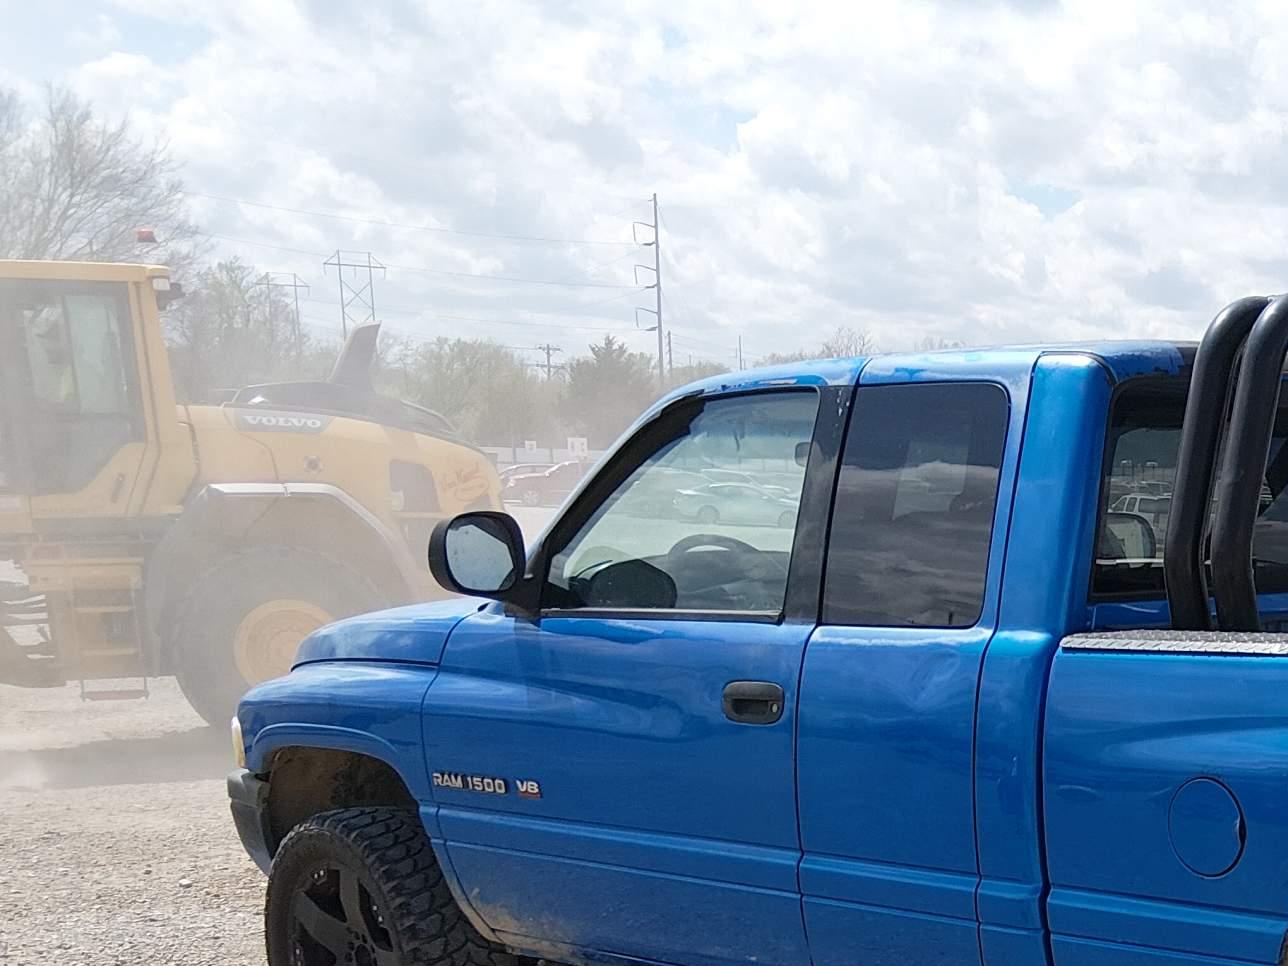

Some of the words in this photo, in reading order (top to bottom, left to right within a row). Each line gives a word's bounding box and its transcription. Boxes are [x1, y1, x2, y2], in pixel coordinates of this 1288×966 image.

[243, 415, 321, 428] VOLVO
[432, 772, 464, 789] RAM
[466, 776, 506, 794] 1500
[516, 780, 540, 794] V8
